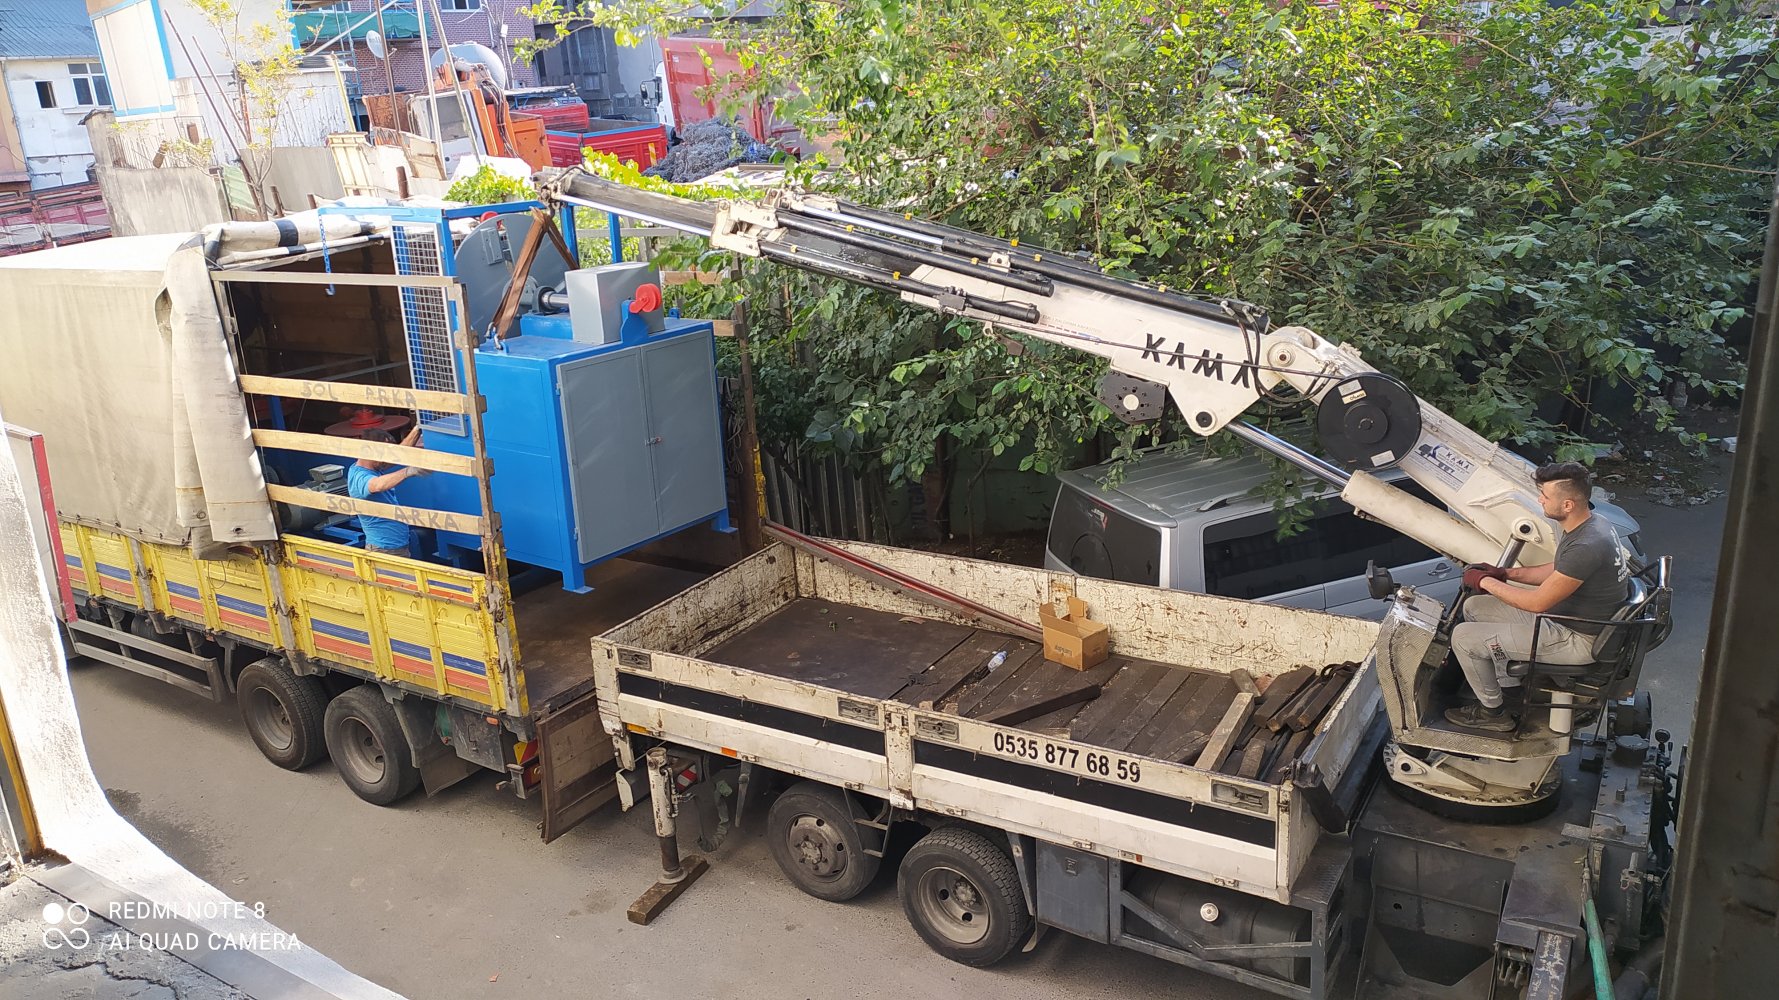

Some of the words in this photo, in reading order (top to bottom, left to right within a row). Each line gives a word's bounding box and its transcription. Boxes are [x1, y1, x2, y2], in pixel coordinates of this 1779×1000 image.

[1141, 333, 1250, 389] KAMA
[301, 382, 338, 401] SOL
[365, 387, 417, 409] ARKA
[1445, 452, 1470, 470] KAMA
[327, 496, 364, 514] SOL
[394, 506, 460, 531] ARKA
[994, 732, 1038, 760] 0535
[1045, 743, 1079, 769] 877
[1086, 752, 1110, 776] 68
[1117, 759, 1141, 783] 59
